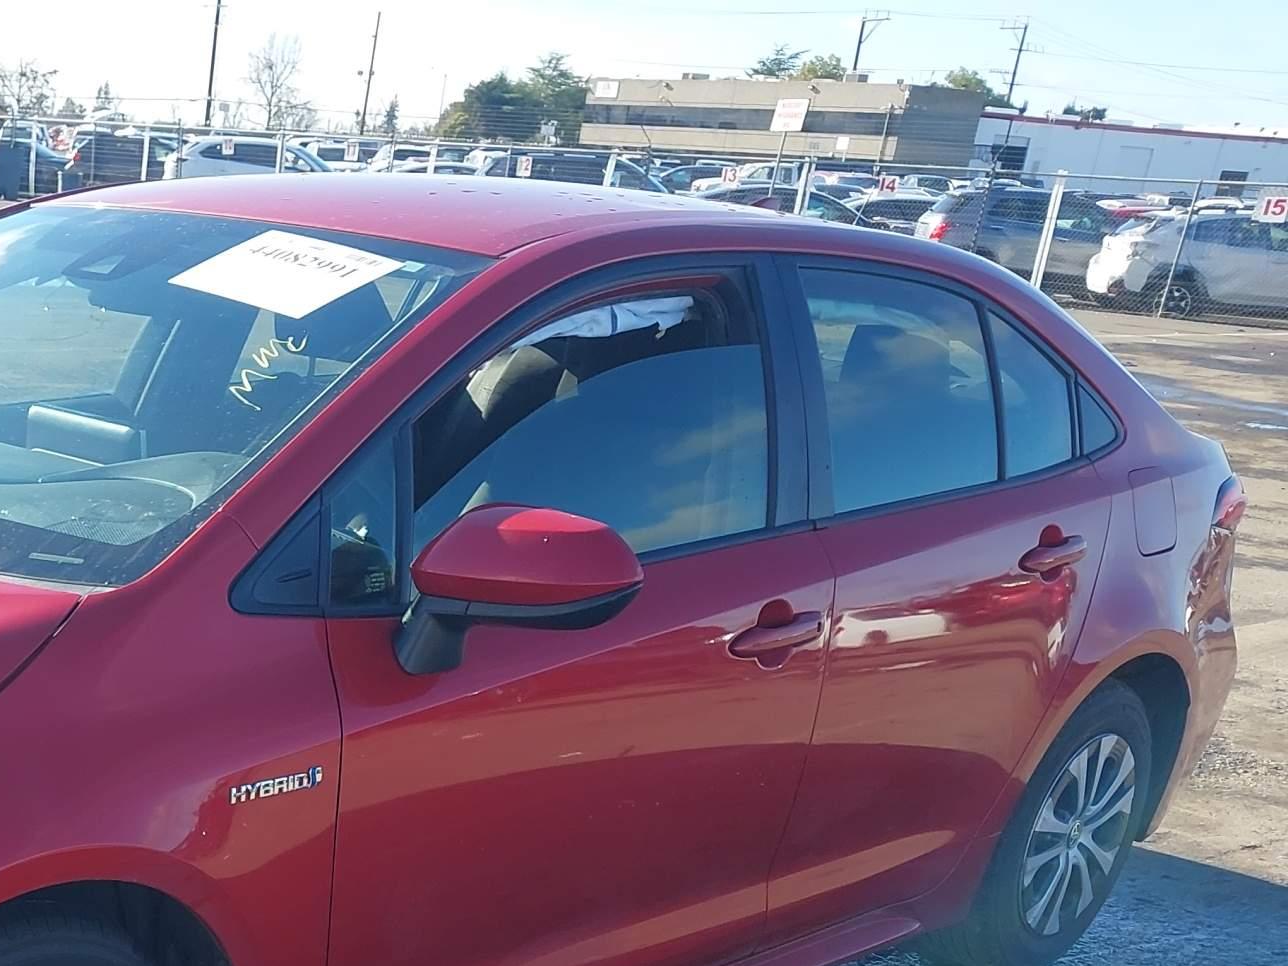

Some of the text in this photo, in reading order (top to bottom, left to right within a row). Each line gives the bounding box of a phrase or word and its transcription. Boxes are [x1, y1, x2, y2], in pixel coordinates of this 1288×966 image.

[723, 168, 737, 182] 13
[880, 177, 896, 192] 14
[1263, 199, 1287, 216] 15
[230, 772, 309, 804] HYBRID
